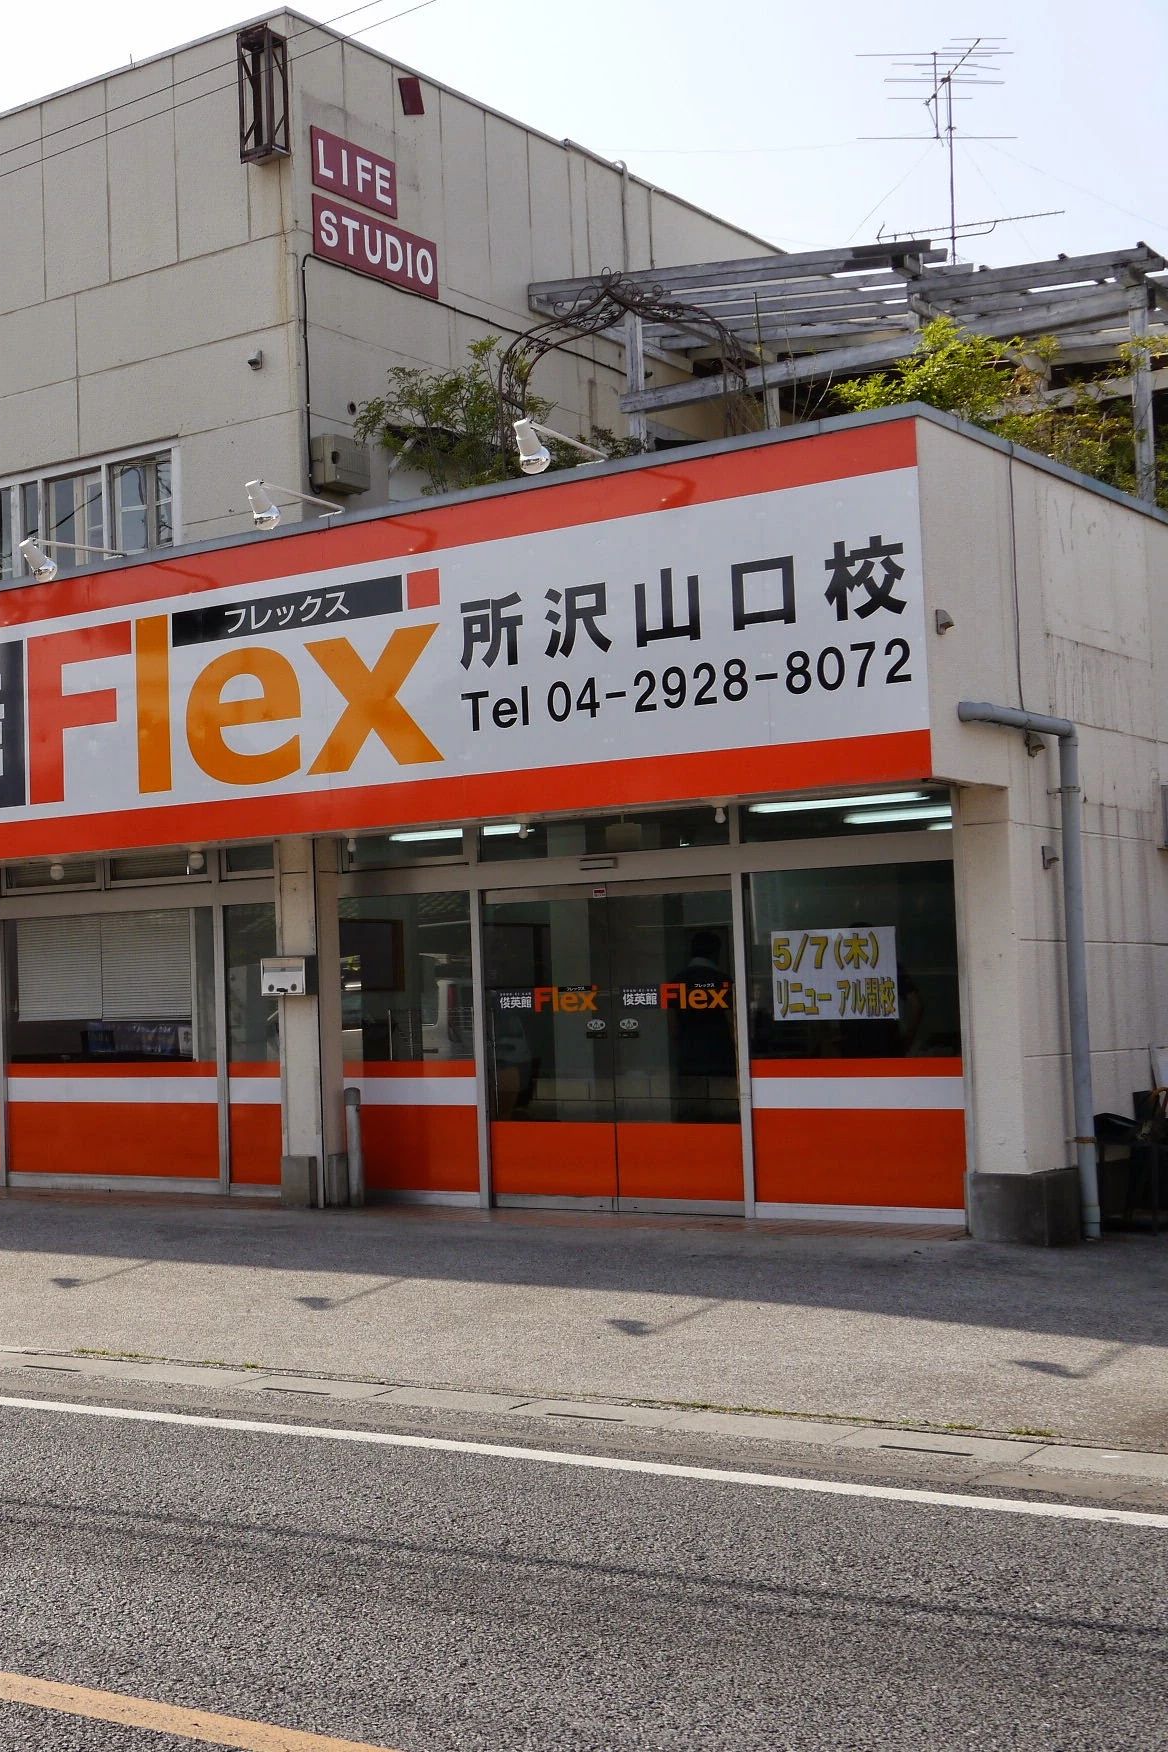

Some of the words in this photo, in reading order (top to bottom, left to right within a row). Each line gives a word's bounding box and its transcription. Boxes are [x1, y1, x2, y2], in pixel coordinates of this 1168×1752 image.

[317, 138, 392, 206] LIFE
[320, 210, 433, 285] STUDIO
[224, 590, 351, 634] フレックス
[459, 534, 908, 672] 所沢山口校
[27, 613, 445, 805] Flex
[461, 685, 530, 732] Tel
[547, 637, 913, 724] 04-2928-8072
[499, 996, 532, 1009] 俊英館
[533, 985, 599, 1013] Flex
[622, 992, 658, 1006] 俊英館
[660, 982, 729, 1009] Flex
